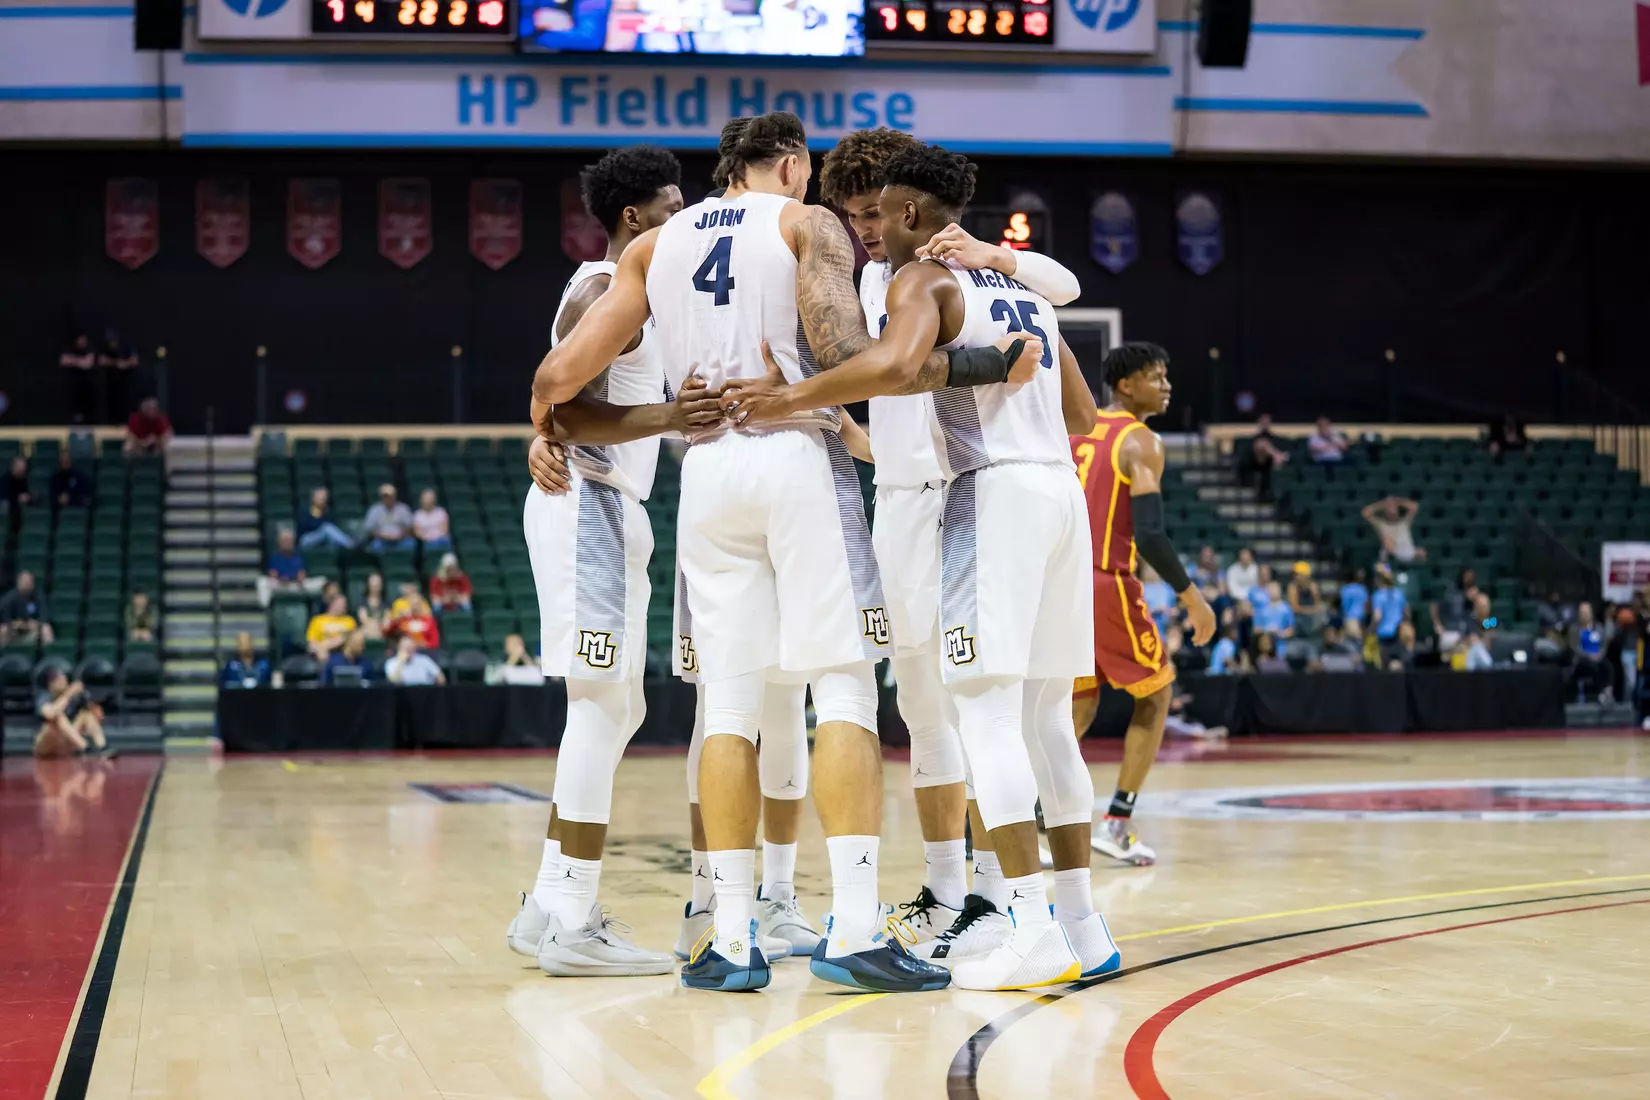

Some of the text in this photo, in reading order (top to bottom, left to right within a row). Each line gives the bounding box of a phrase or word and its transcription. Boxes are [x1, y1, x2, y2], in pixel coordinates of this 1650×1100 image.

[458, 74, 916, 129] HP Field House
[694, 208, 746, 230] JOHN
[692, 235, 735, 306] 4
[862, 607, 890, 646] MU
[944, 625, 977, 667] MU
[576, 628, 617, 670] MU
